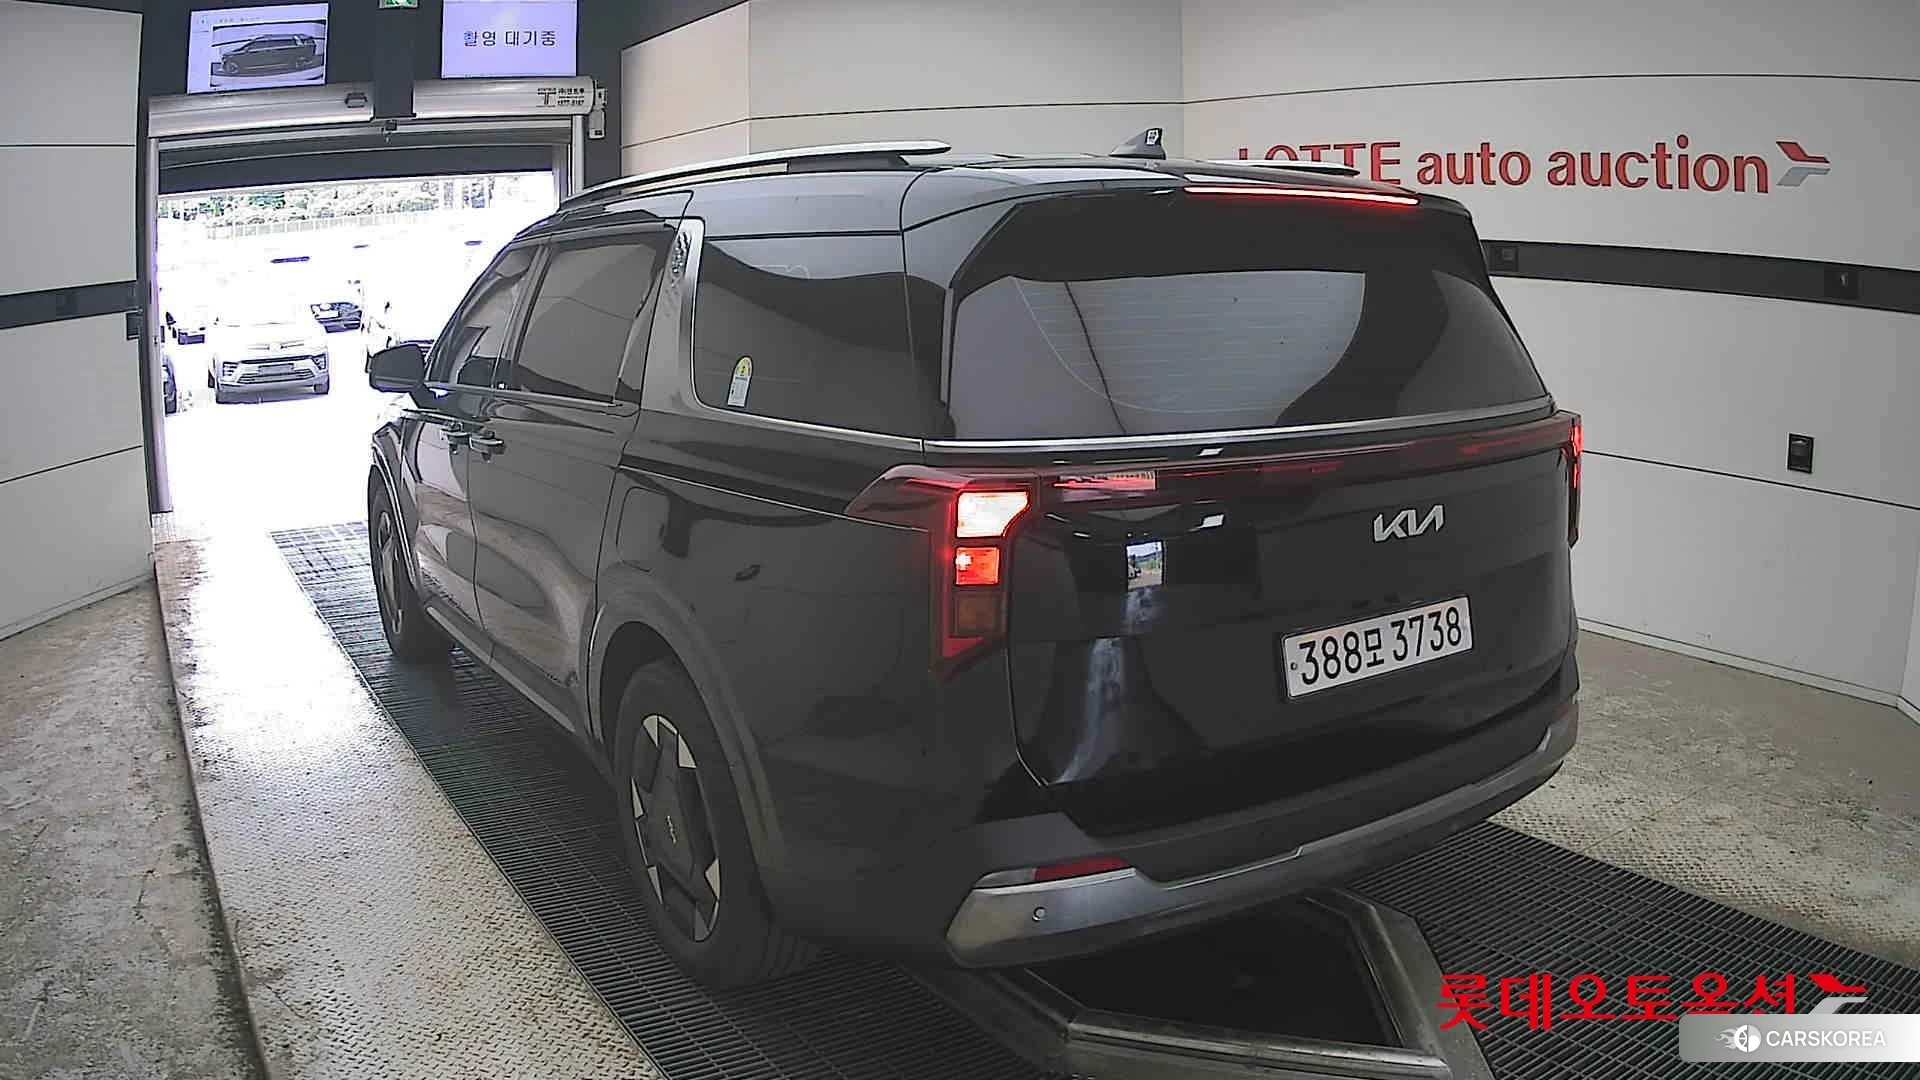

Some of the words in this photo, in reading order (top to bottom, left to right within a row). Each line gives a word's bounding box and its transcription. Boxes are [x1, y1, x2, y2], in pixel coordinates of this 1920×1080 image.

[505, 30, 556, 46] 대기중
[1416, 142, 1531, 186] auto
[1548, 134, 1768, 193] auction
[1373, 504, 1444, 542] KIA
[1390, 606, 1462, 661] 3738
